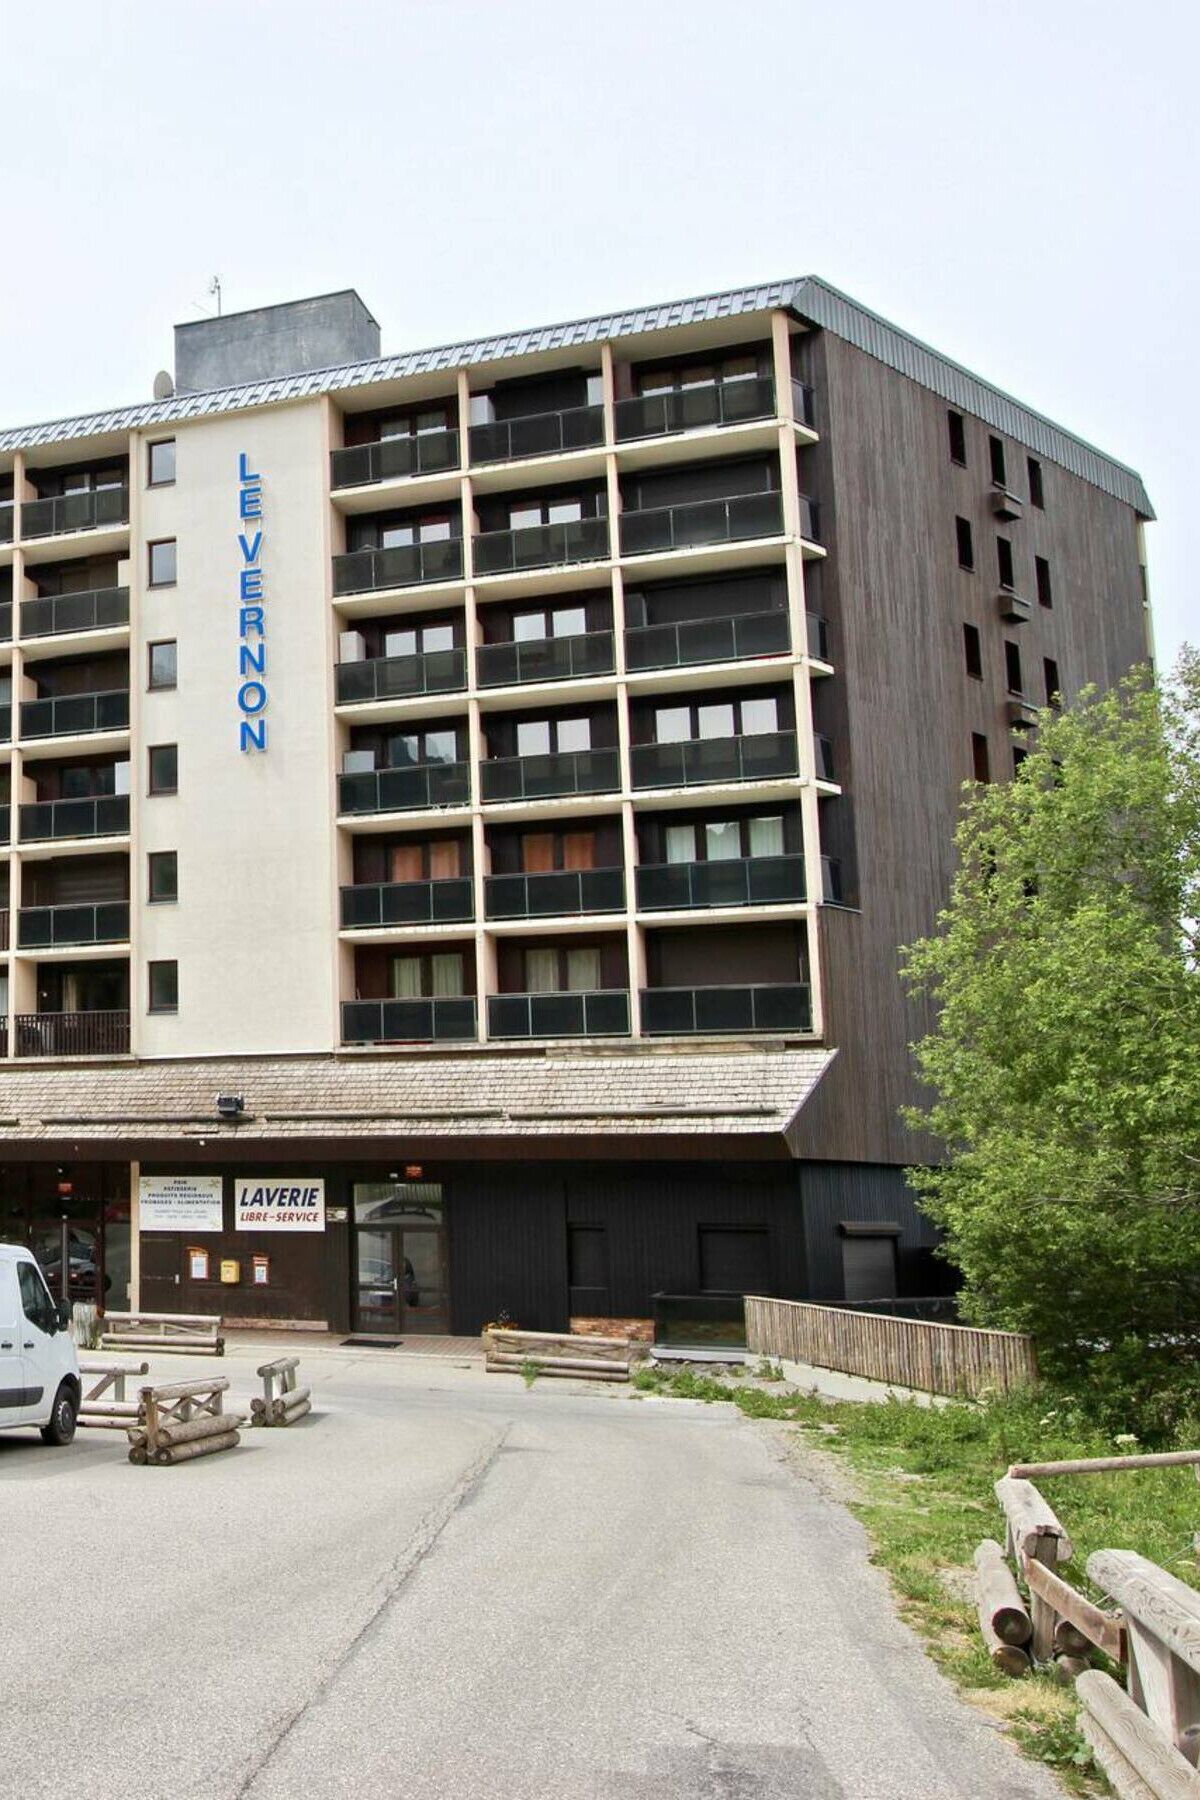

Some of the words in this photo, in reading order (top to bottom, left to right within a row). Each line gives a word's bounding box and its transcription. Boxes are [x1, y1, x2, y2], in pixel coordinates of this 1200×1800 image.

[238, 453, 262, 520] LE
[237, 532, 266, 751] VERNON
[240, 1187, 320, 1207] LAVERIE
[240, 1211, 320, 1222] LIBRE-SERVICE
